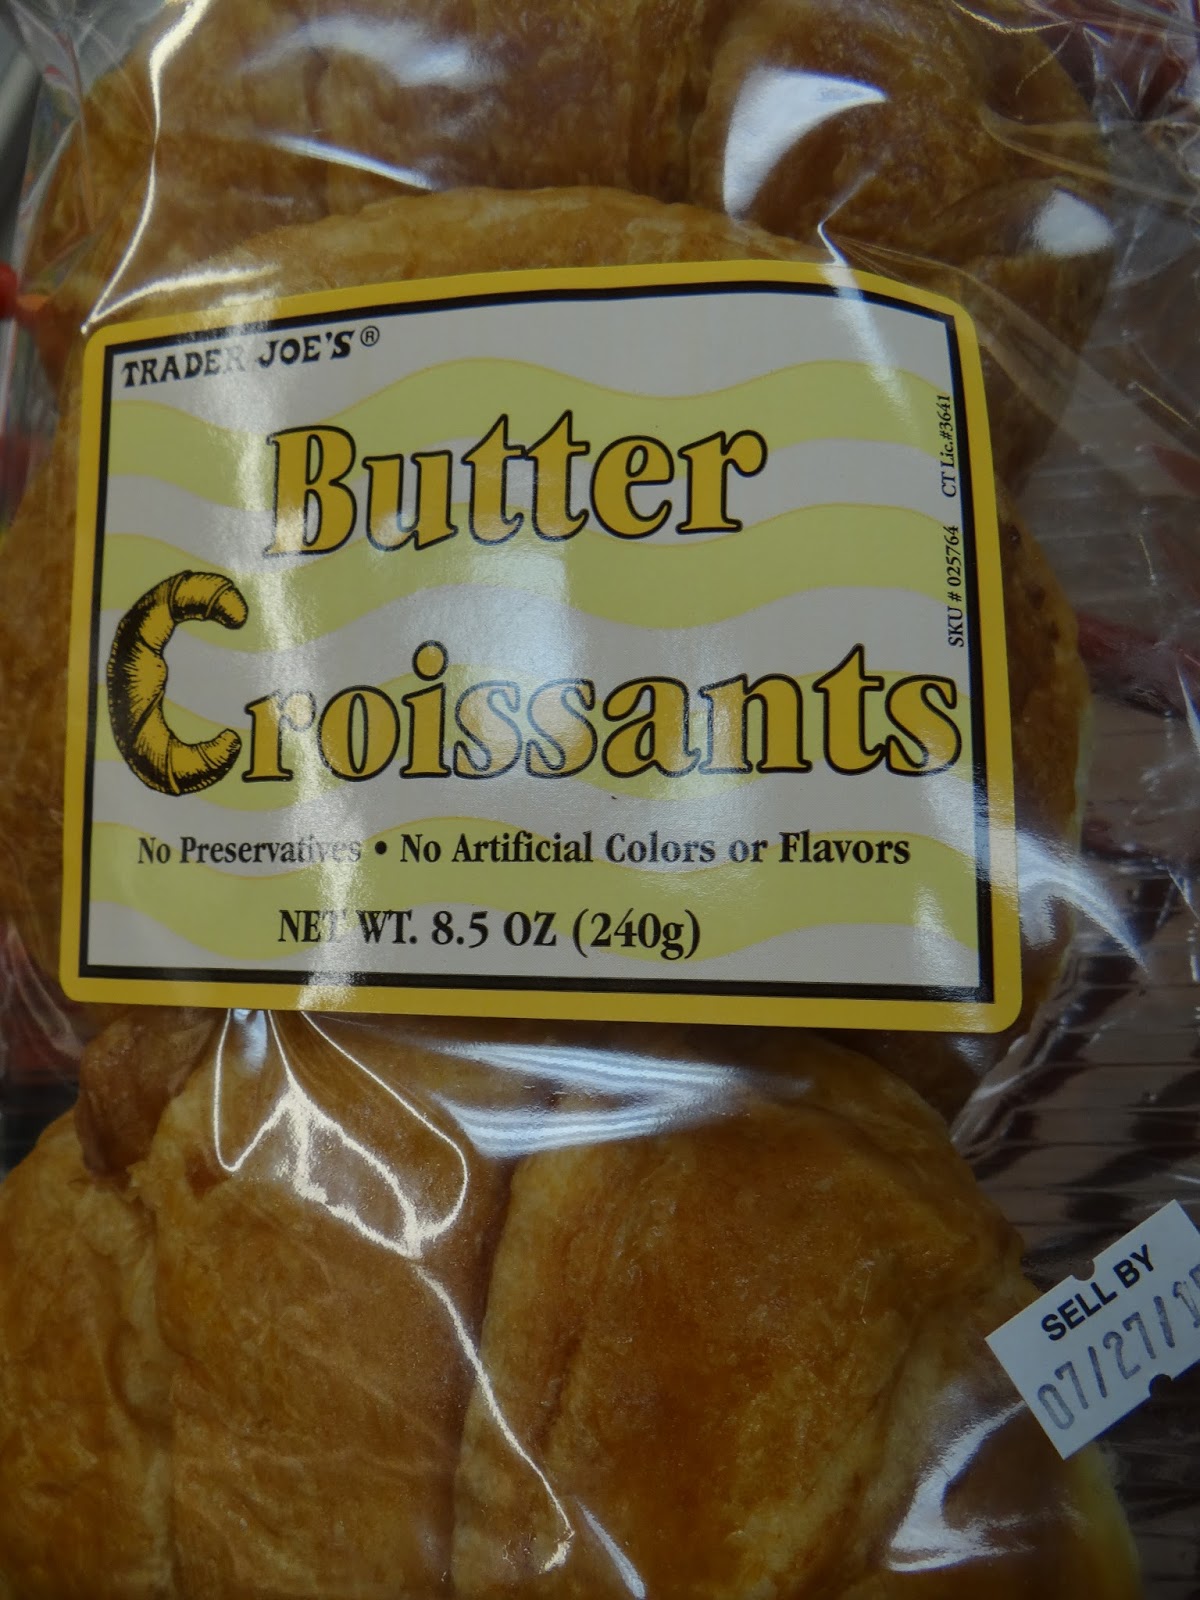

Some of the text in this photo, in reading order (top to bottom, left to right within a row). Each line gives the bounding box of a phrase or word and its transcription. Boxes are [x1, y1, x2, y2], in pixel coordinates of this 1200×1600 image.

[121, 343, 248, 388] TRADER
[262, 410, 768, 557] Butter
[940, 470, 957, 498] CT
[943, 525, 961, 588] 025764
[947, 606, 965, 648] SKU
[107, 569, 963, 797] Croissants
[137, 830, 911, 866] No Preservatives No Artificial Colors or Flavors
[277, 907, 701, 961] NET WT. 8.5 OZ (240g)
[1040, 1243, 1155, 1342] SELL BY
